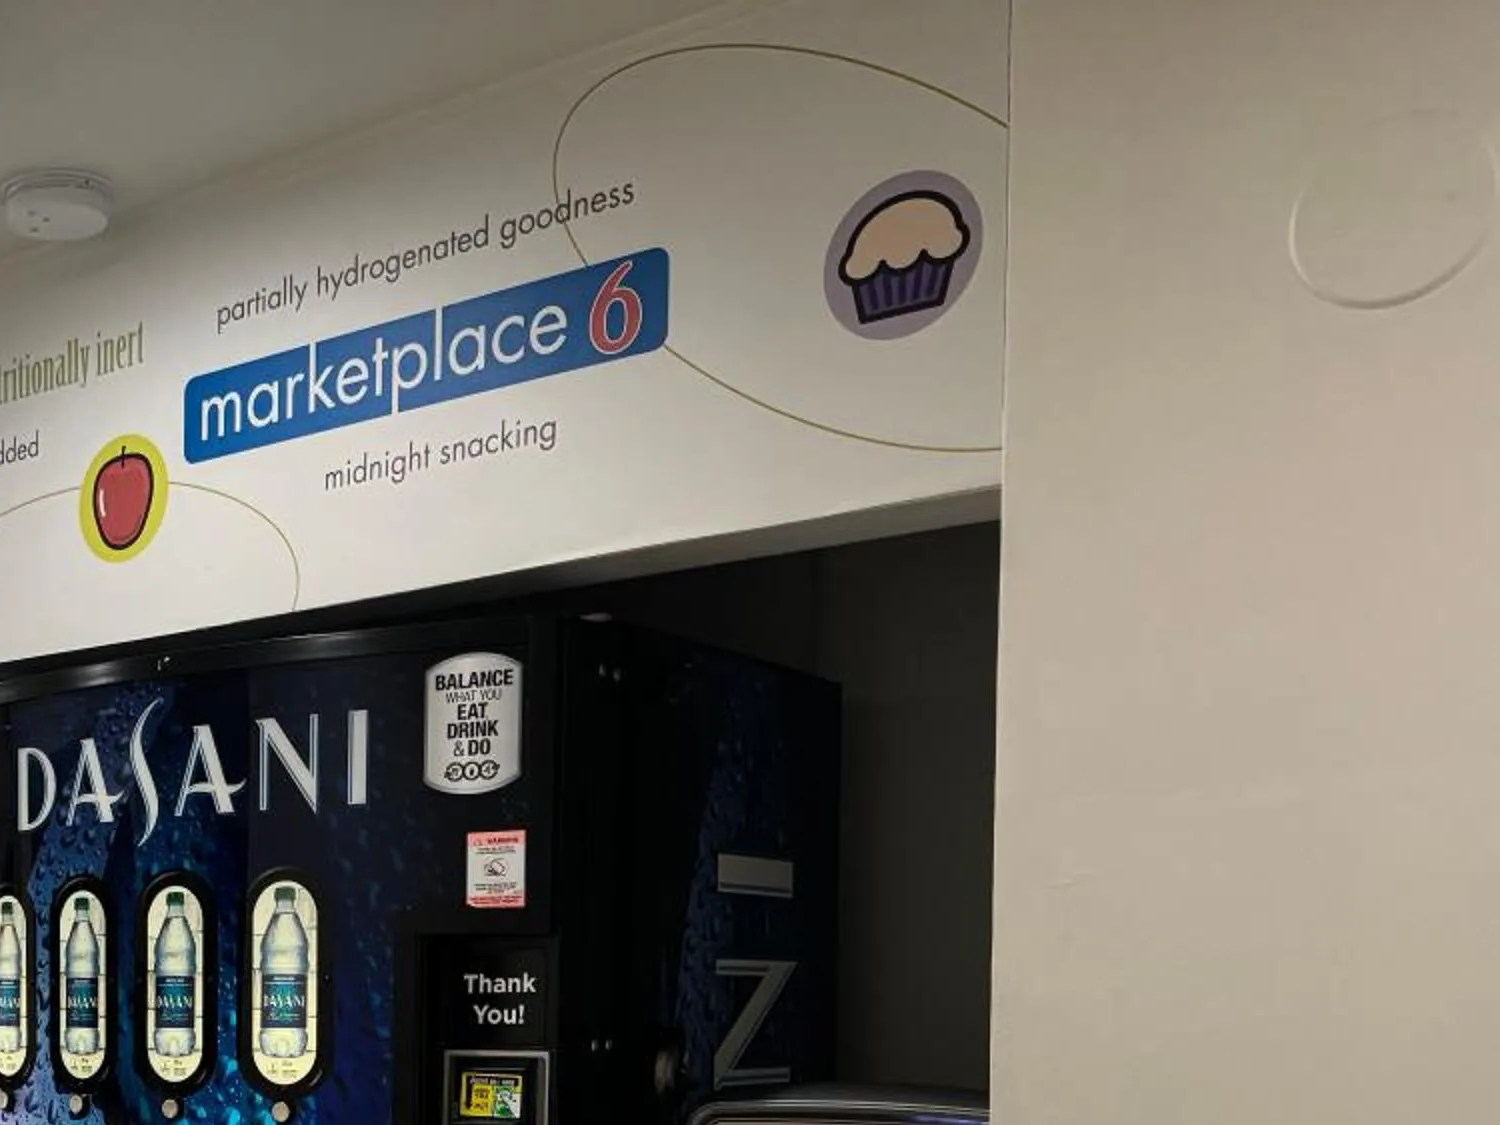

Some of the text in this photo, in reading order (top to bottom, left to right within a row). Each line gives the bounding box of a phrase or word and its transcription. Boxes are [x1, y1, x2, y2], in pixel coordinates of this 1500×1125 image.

[216, 180, 636, 335] partially hydrogenated goodness
[97, 320, 146, 378] inert
[199, 259, 644, 443] marketplace 6
[324, 416, 558, 492] midnight snacking
[435, 668, 515, 691] BALANCE
[445, 687, 503, 704] WHAT YOU
[457, 701, 489, 721] EAT
[447, 719, 500, 739] DRINK
[453, 737, 491, 757] & DO
[17, 696, 369, 848] DASANI
[463, 971, 537, 995] Thank
[473, 1003, 526, 1025] You!
